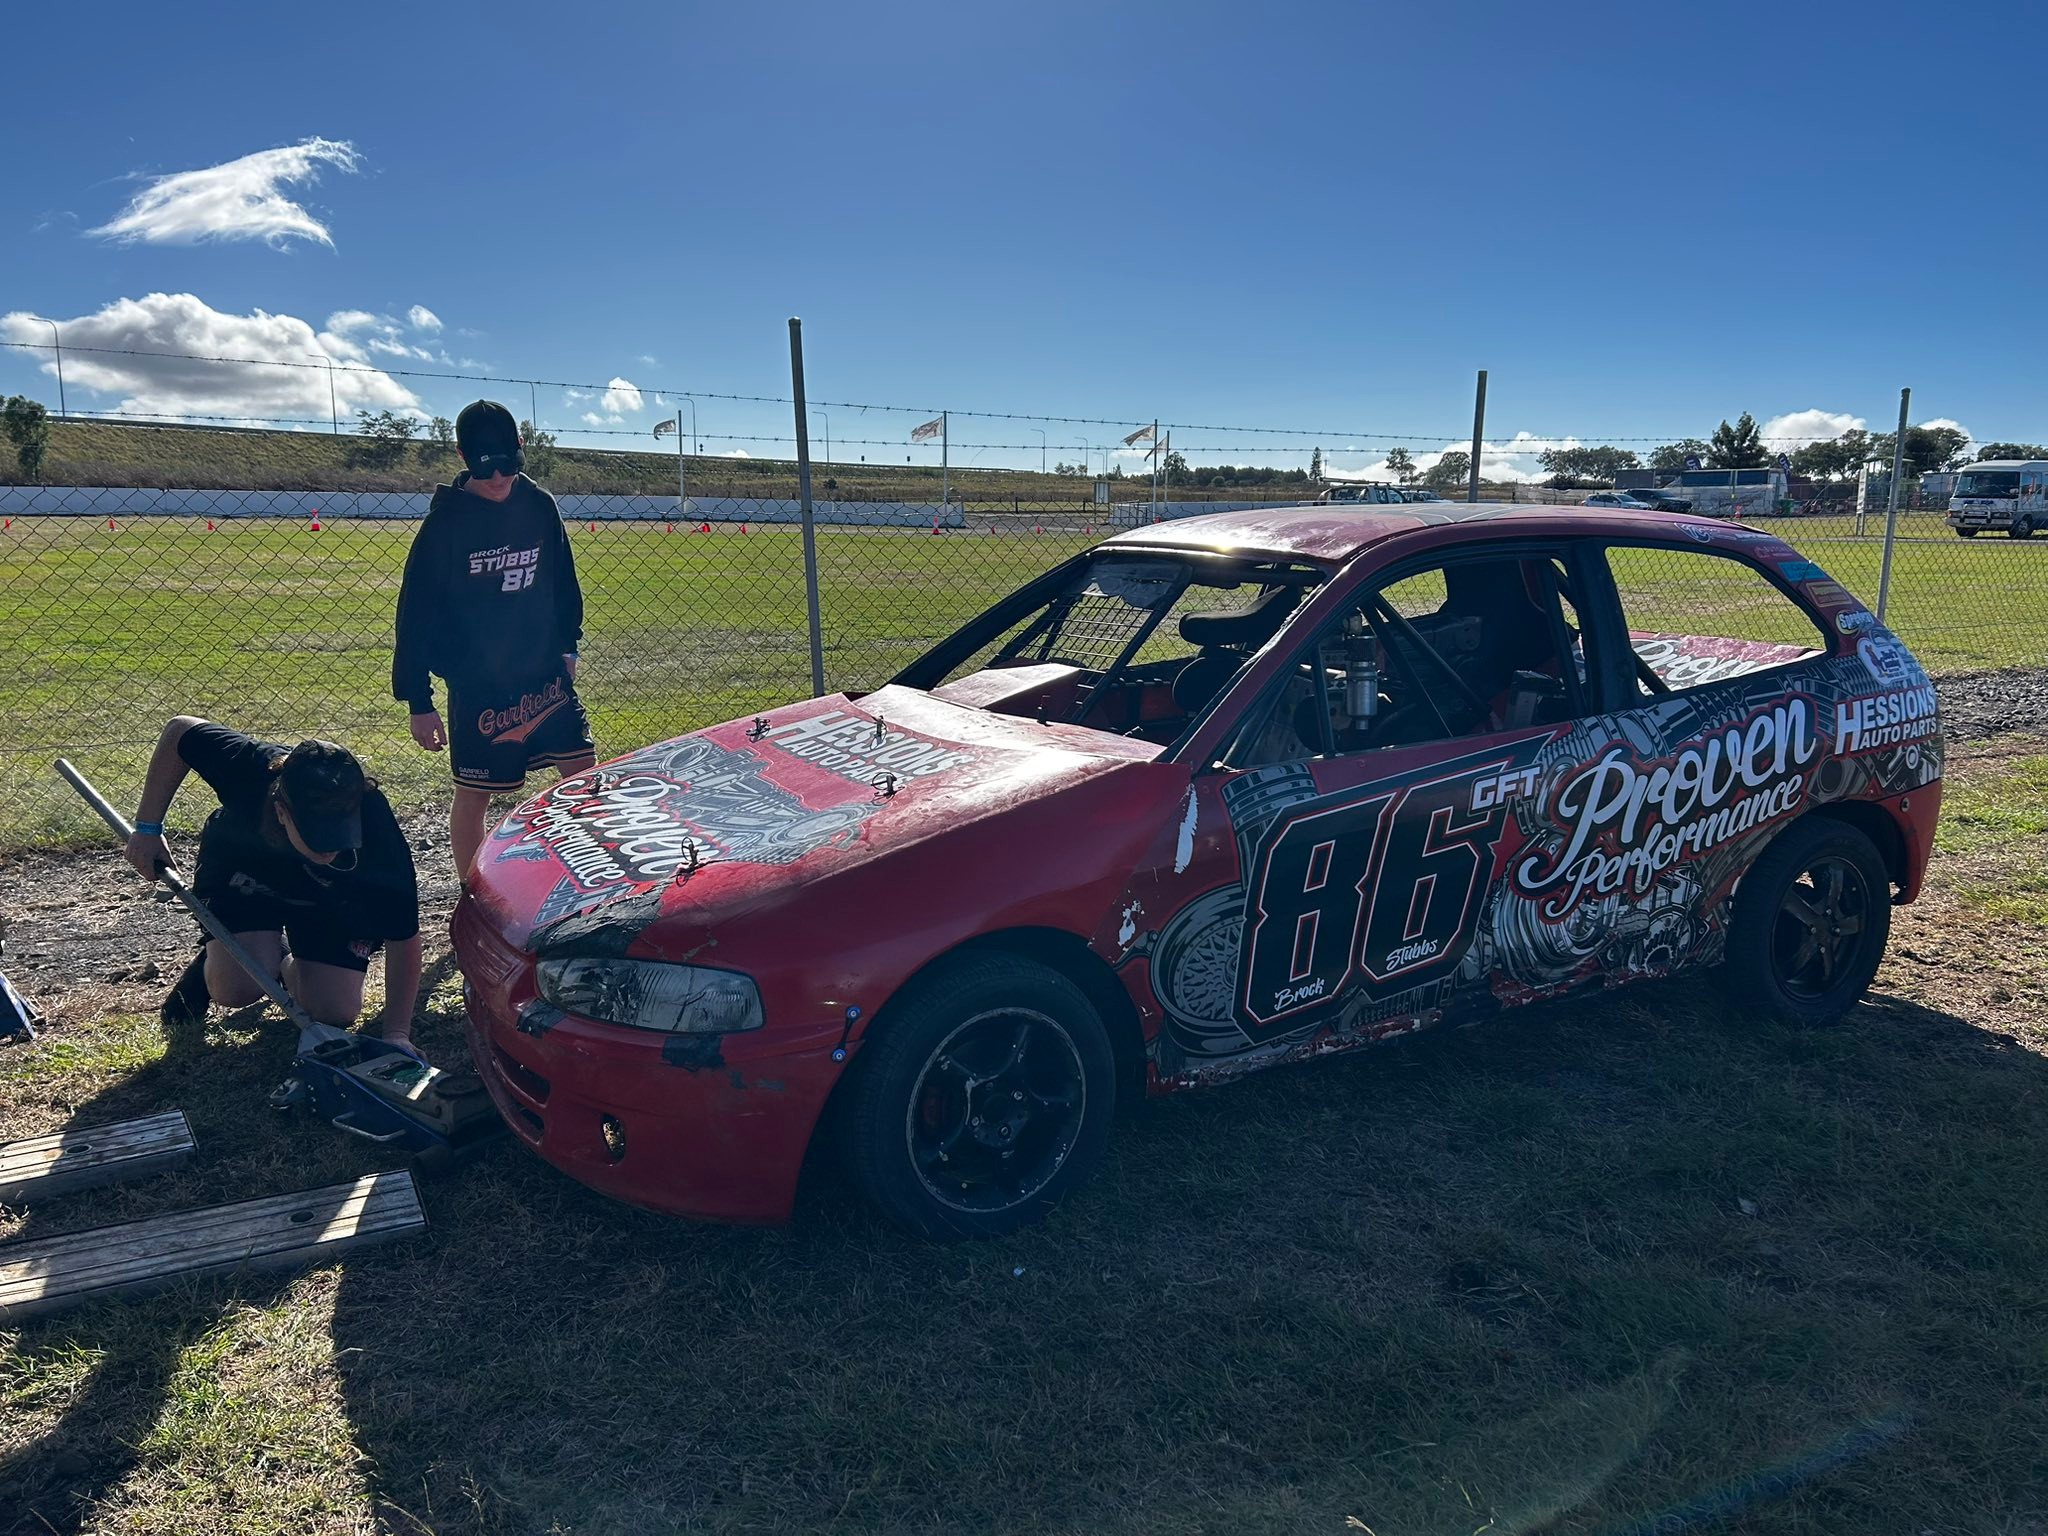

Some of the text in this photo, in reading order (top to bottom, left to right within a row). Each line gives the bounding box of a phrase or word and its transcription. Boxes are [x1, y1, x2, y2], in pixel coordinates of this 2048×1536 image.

[469, 545, 509, 559] BROCK
[470, 547, 540, 574] STUBBS
[502, 564, 537, 591] 86
[478, 677, 563, 736] Garfield
[1835, 686, 1937, 755] HESSIONS
[765, 710, 977, 776] HESSIONS
[788, 739, 851, 766] AUTO
[1859, 717, 1937, 750] AUTO PARTS
[1471, 767, 1541, 811] GFT
[1518, 698, 1817, 889] Proven
[518, 797, 626, 888] Performance
[553, 776, 720, 875] Proven
[1545, 774, 1803, 919] Performance
[1246, 760, 1512, 1024] 86
[1386, 939, 1438, 972] Stubbs
[1274, 977, 1325, 1011] Brock
